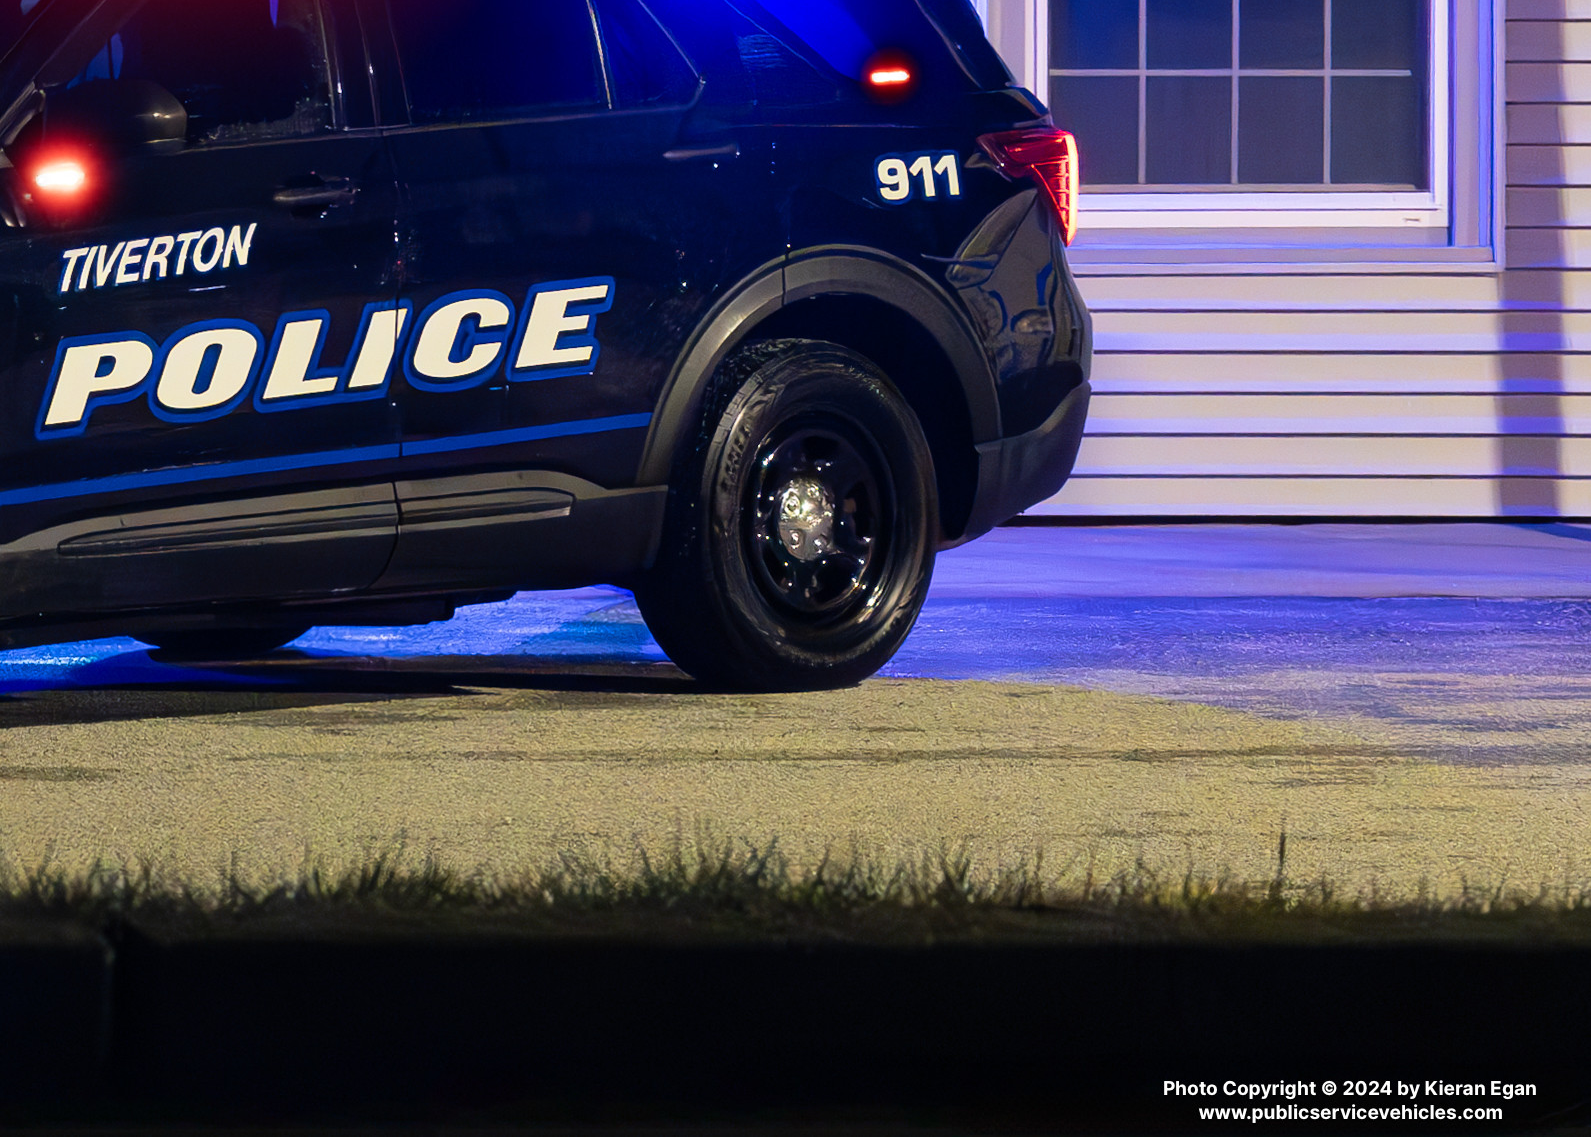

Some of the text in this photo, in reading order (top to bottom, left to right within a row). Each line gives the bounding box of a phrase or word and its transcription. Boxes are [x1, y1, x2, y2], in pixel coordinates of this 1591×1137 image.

[878, 155, 959, 199] 911
[59, 222, 258, 293] TIVERTON
[38, 278, 614, 438] POLICE
